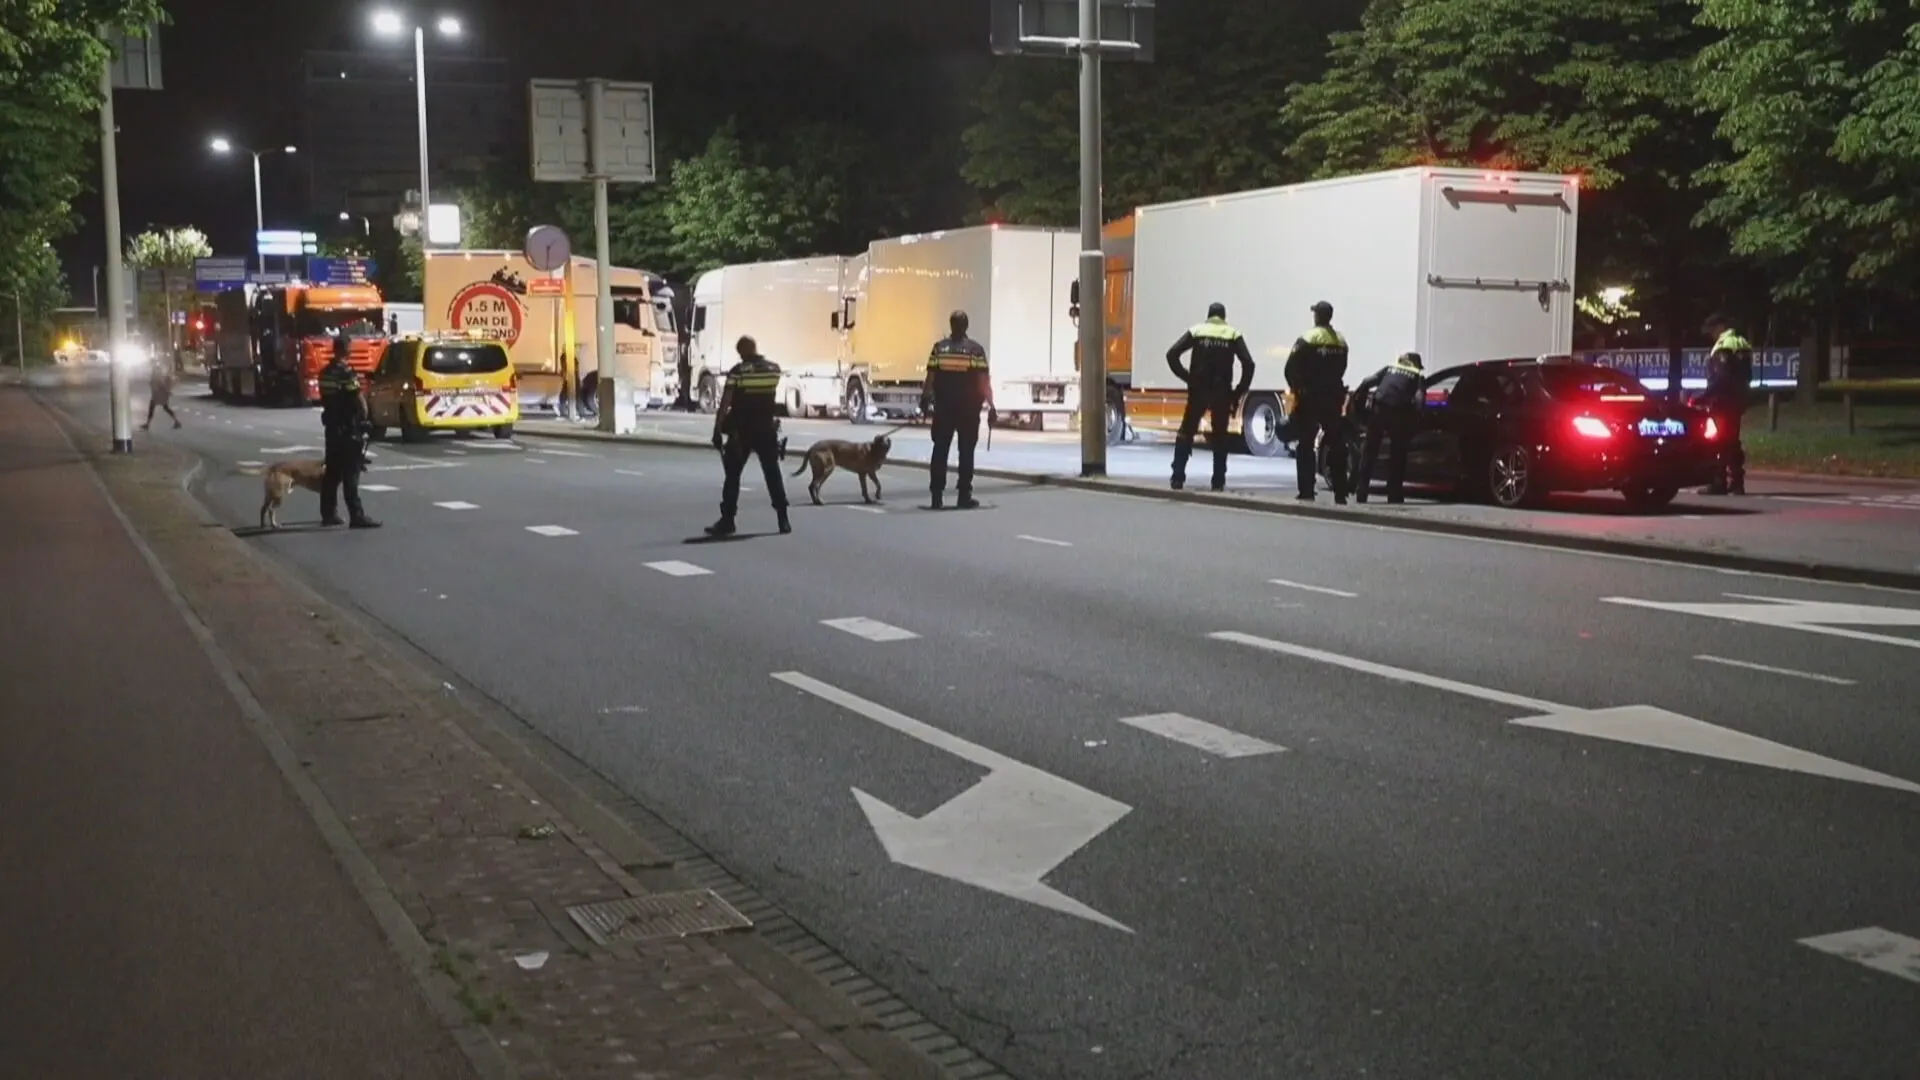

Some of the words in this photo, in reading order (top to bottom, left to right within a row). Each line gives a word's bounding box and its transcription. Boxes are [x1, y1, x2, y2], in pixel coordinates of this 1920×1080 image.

[468, 300, 488, 312] 1.5
[493, 300, 506, 313] M
[465, 316, 488, 326] VAN
[492, 316, 508, 326] DE
[1615, 352, 1671, 368] PARKIN
